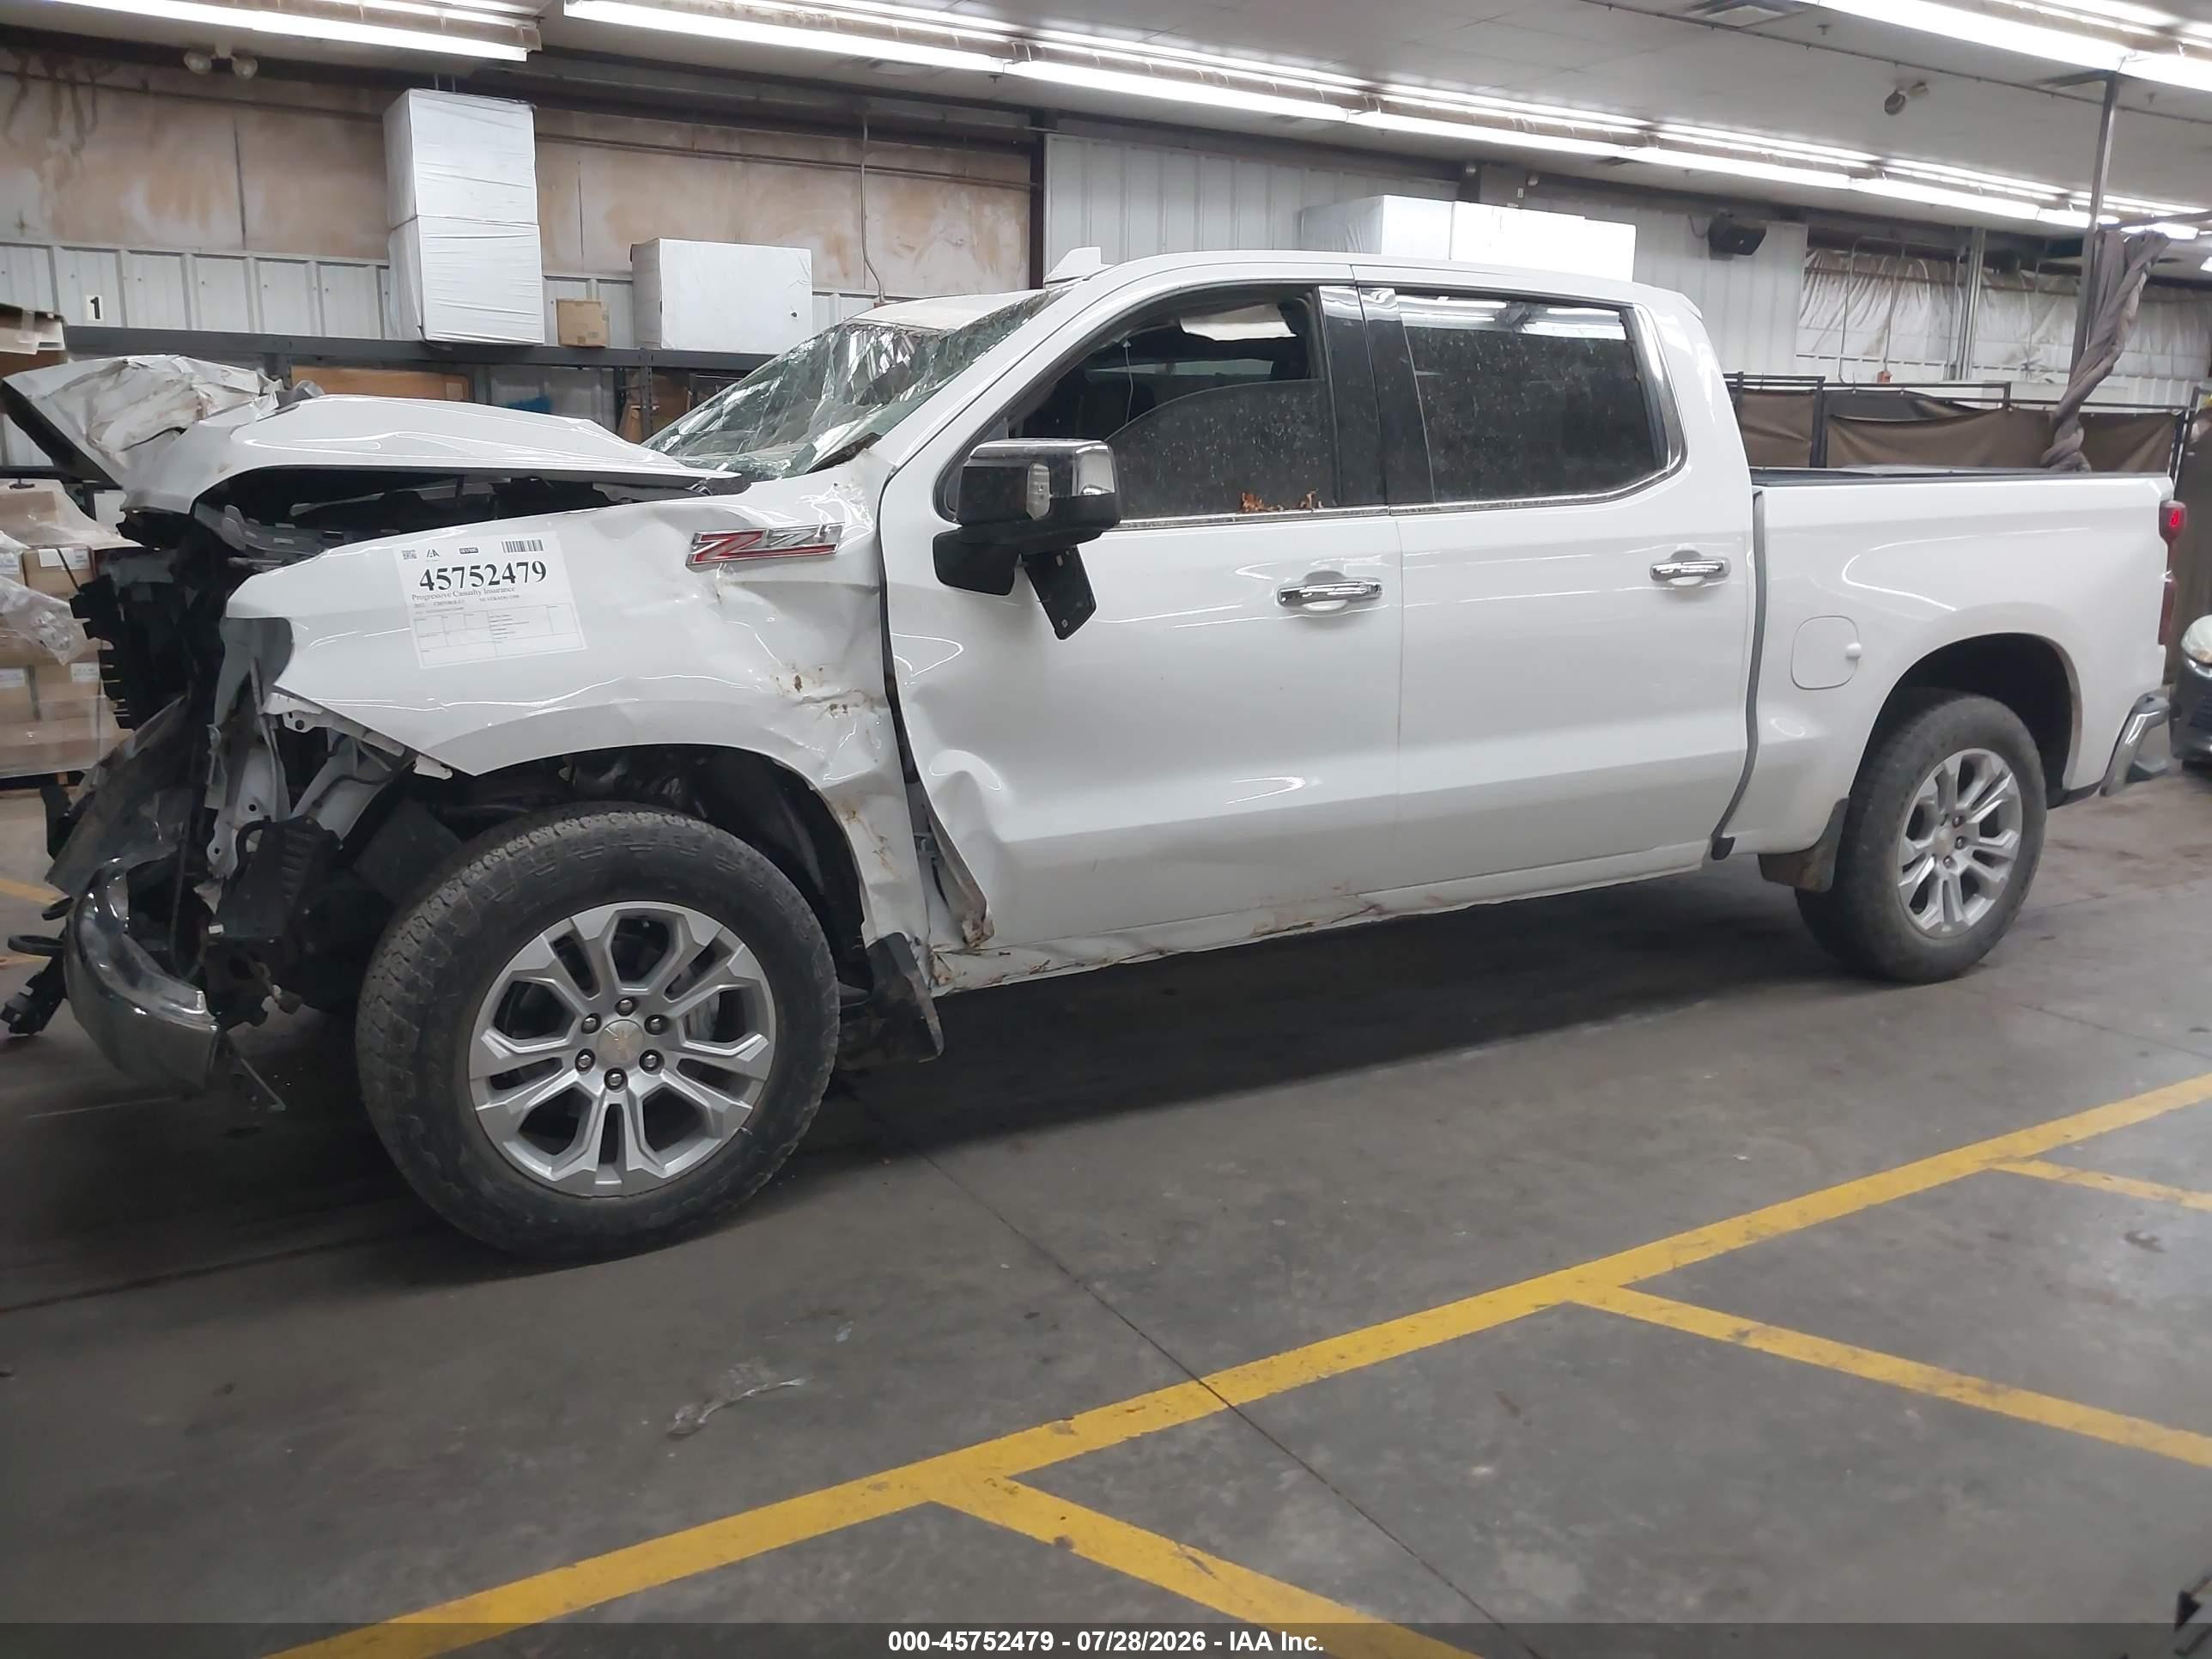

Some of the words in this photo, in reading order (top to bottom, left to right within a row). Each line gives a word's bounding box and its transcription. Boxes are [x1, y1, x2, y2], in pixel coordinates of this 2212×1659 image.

[89, 295, 100, 319] 1
[419, 560, 547, 592] 45752479
[411, 592, 453, 601] Progressive
[453, 589, 482, 598] Casualty
